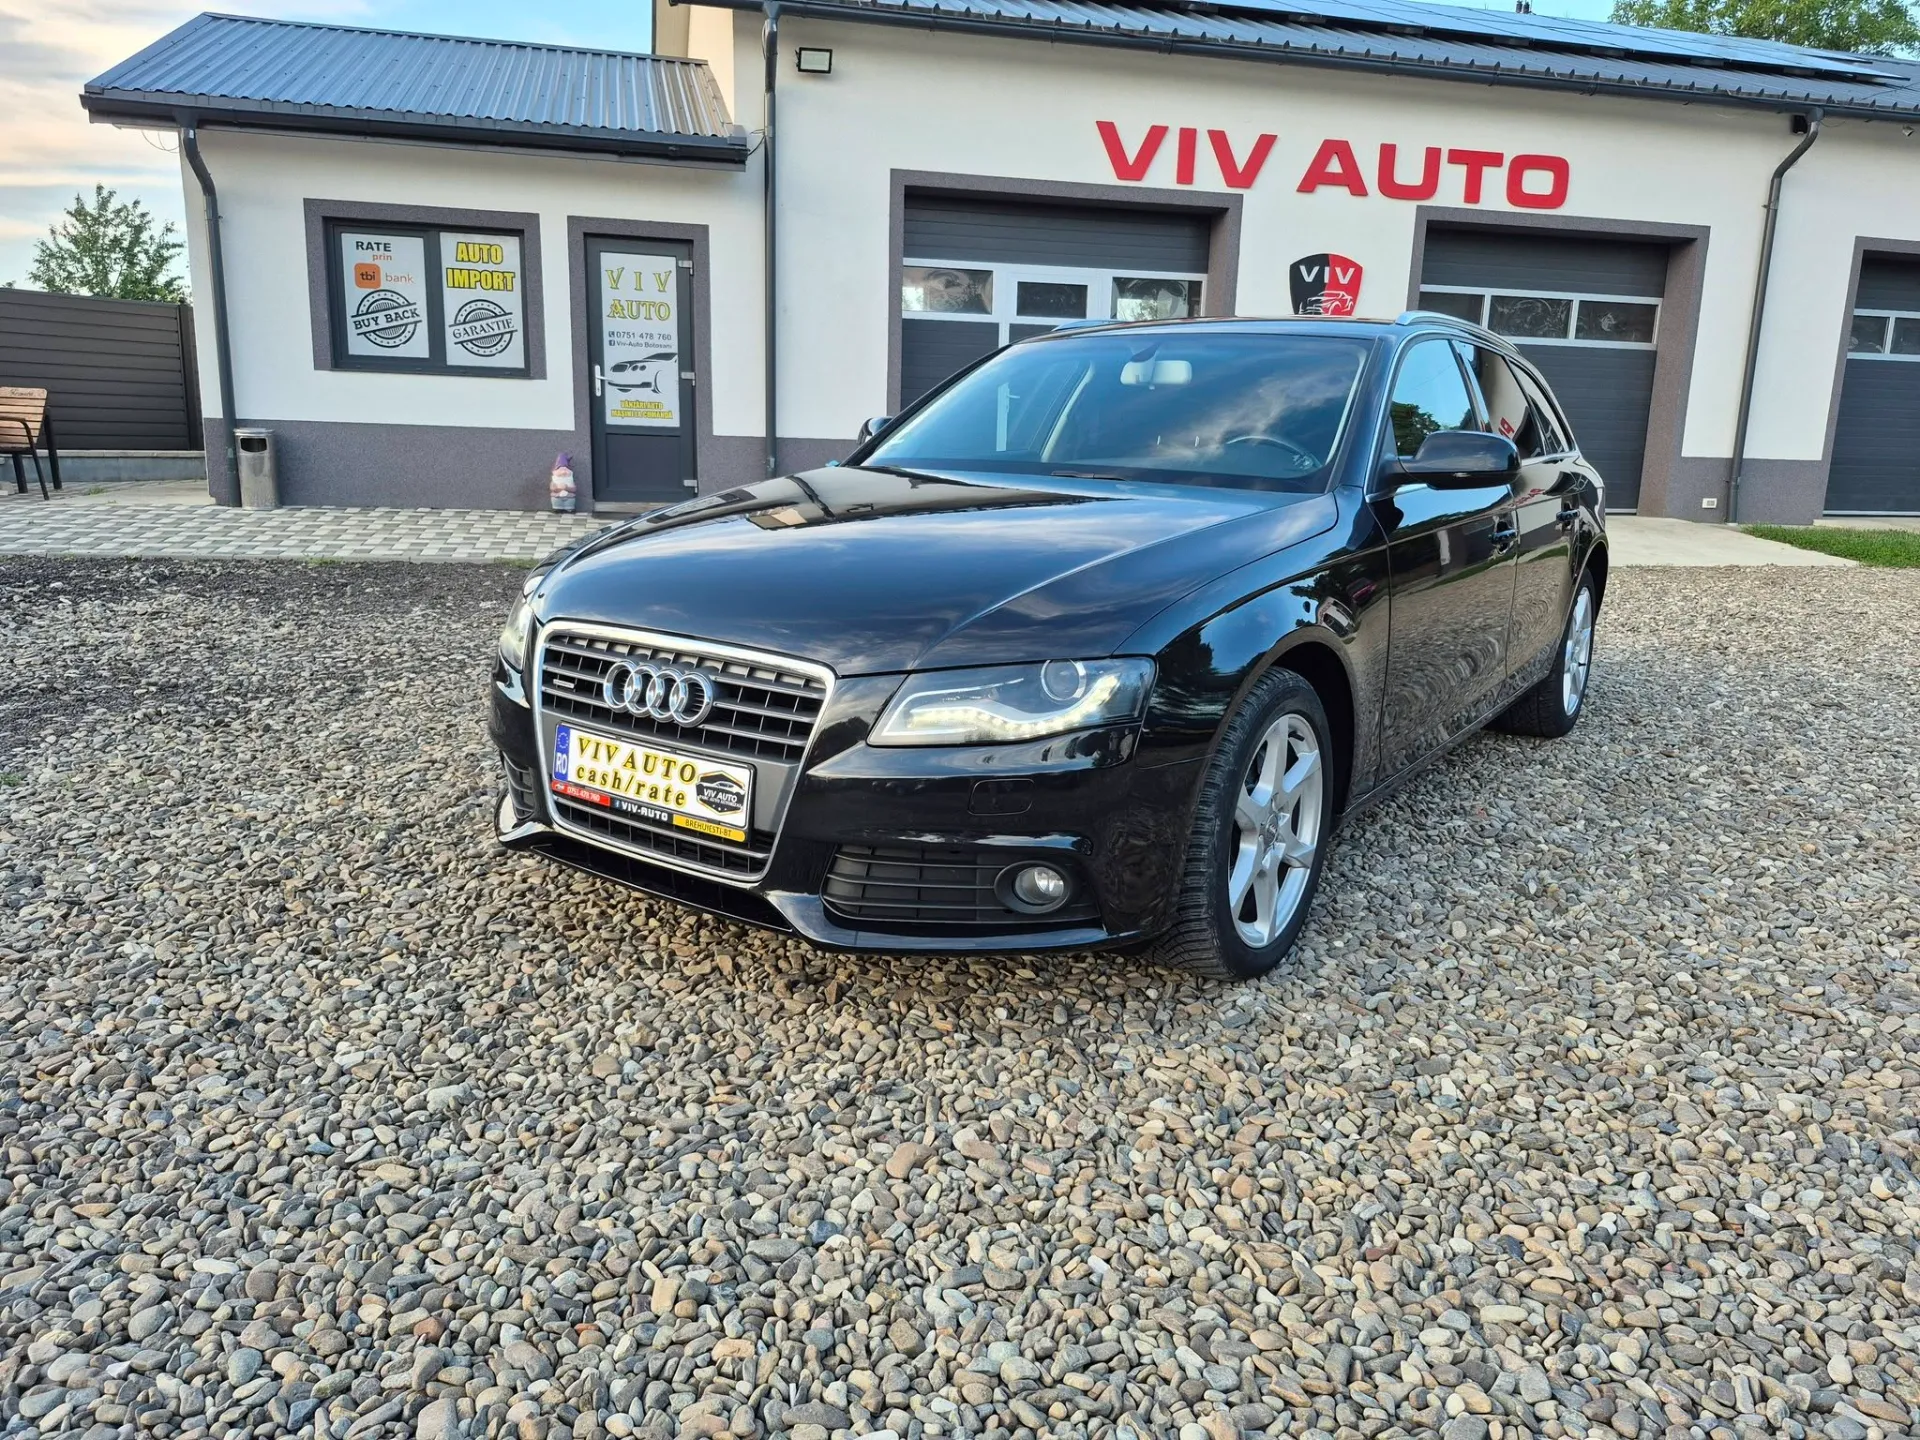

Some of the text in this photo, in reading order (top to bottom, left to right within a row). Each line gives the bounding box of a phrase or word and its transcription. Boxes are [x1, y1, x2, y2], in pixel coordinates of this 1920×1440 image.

[1096, 120, 1570, 210] VIV AUTO
[355, 241, 392, 252] RATE
[372, 253, 392, 261] prin
[456, 242, 503, 264] AUTO
[360, 271, 414, 284] tbi bank
[446, 268, 516, 292] IMPORT
[1299, 265, 1356, 285] VIV
[353, 308, 420, 330] BUY BACK
[607, 299, 671, 321] AUTO
[452, 317, 514, 339] GARANTIE
[616, 331, 672, 341] 0751 478 760
[616, 340, 643, 348] Viv-Auto
[555, 752, 568, 774] RO
[578, 737, 696, 783] VIV AUTO
[576, 766, 686, 806] cash/rate
[704, 788, 717, 799] VIV
[717, 792, 738, 803] AUTO
[621, 801, 668, 821] VIV-AUTO
